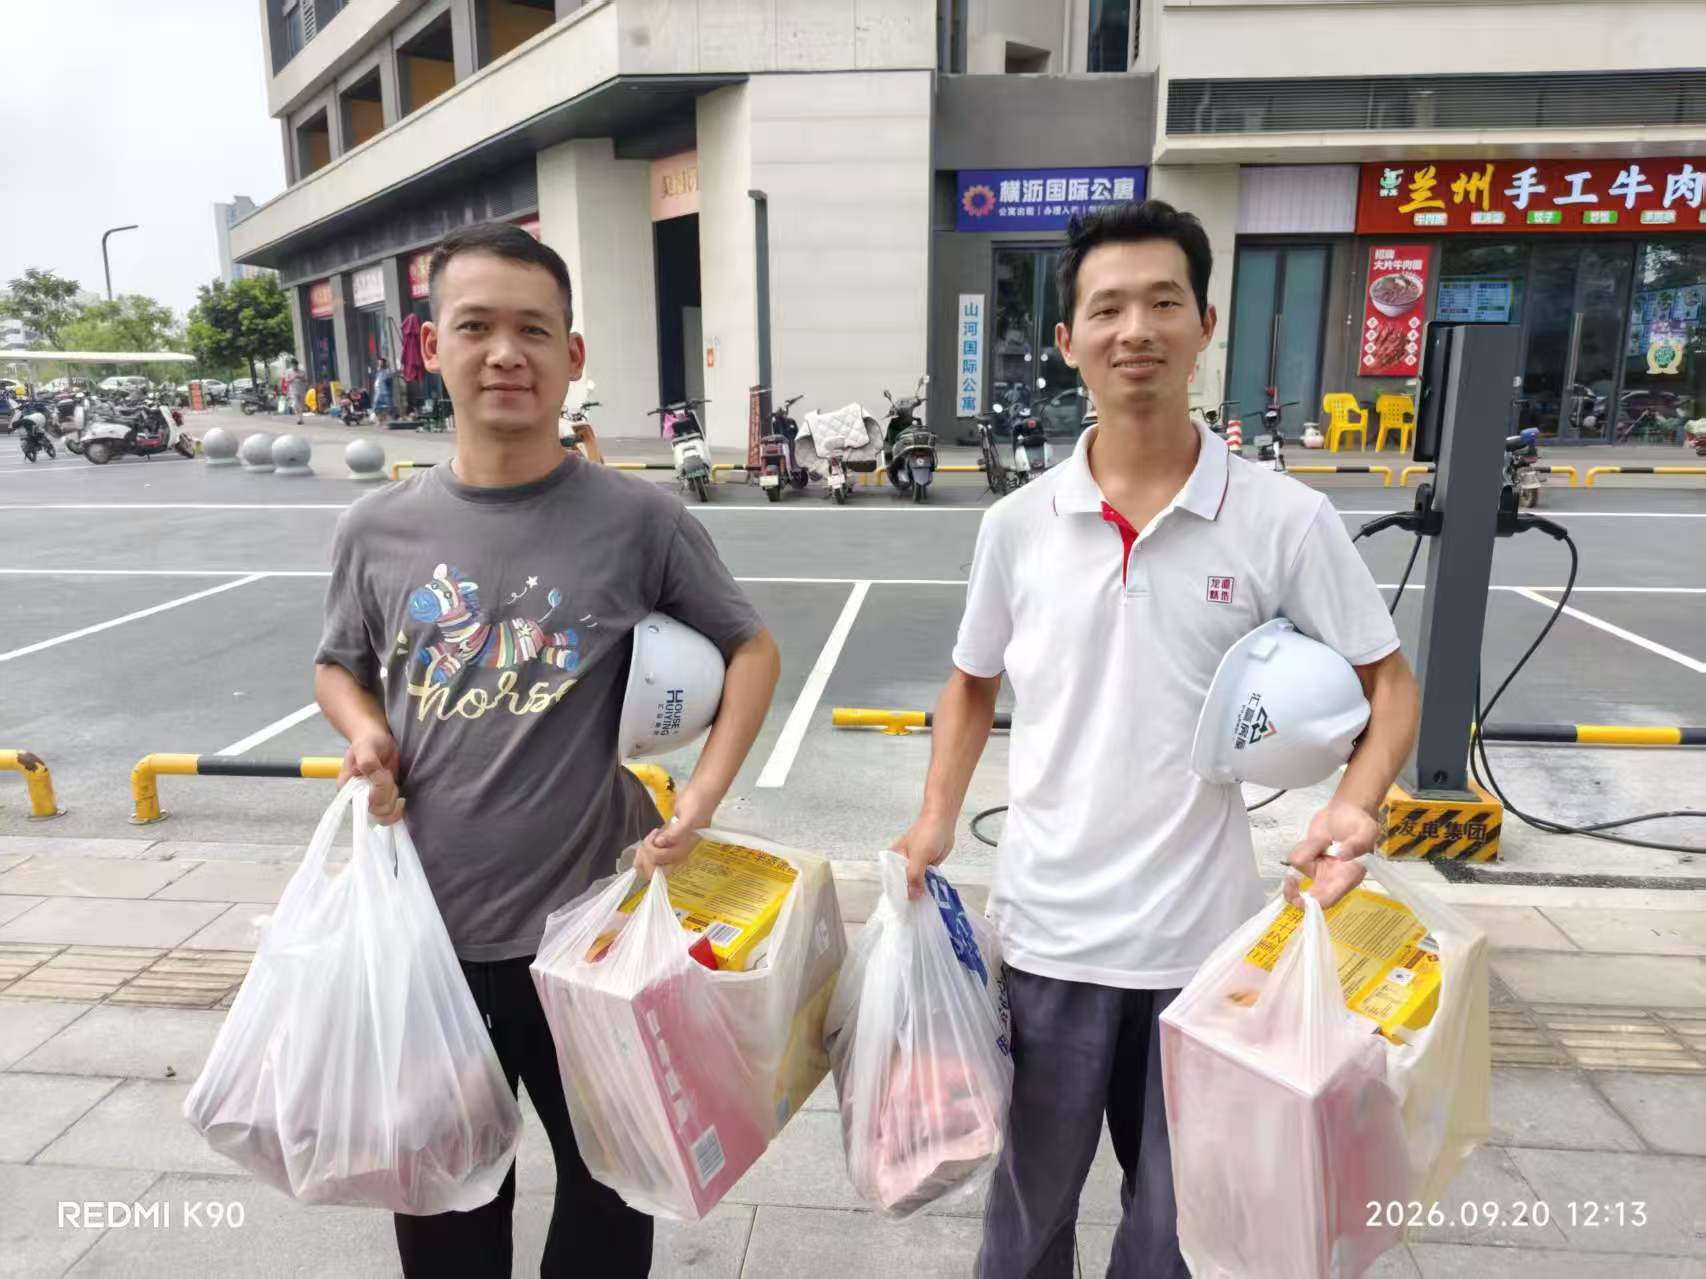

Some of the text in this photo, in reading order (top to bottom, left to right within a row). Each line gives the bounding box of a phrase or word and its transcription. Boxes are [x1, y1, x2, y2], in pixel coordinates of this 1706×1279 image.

[999, 178, 1135, 203] 横沥国际公寓
[1398, 163, 1704, 213] 兰州手工牛肉
[961, 302, 979, 411] 山河国际公寓
